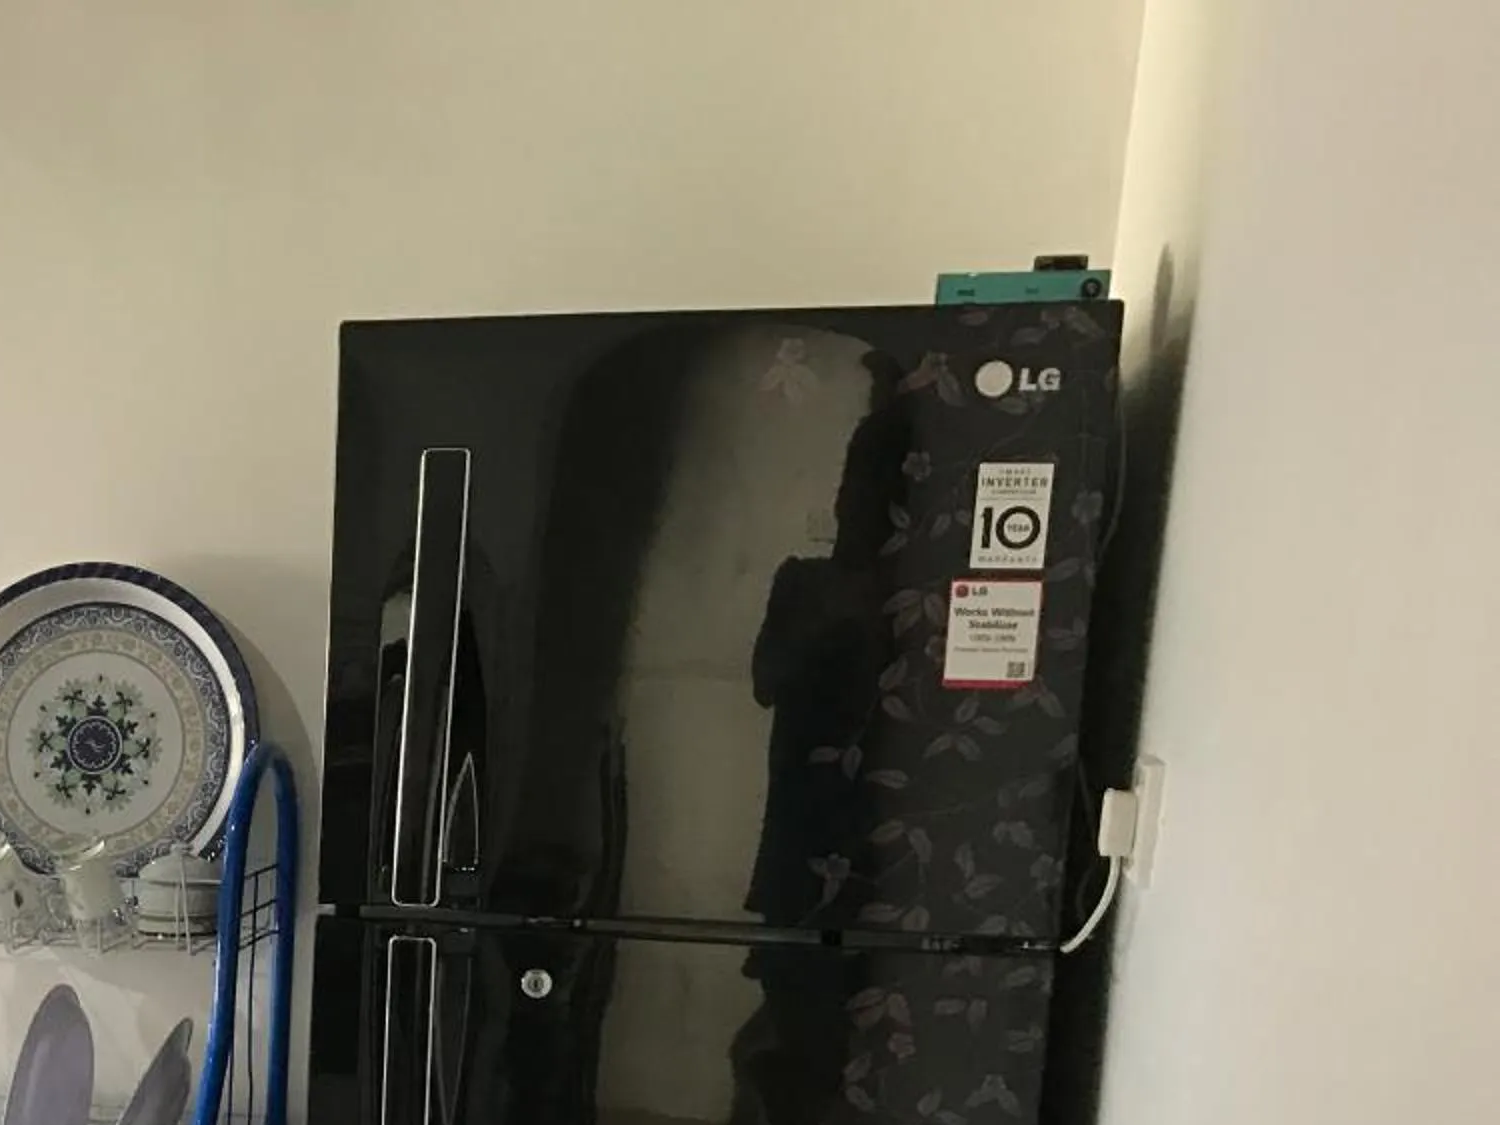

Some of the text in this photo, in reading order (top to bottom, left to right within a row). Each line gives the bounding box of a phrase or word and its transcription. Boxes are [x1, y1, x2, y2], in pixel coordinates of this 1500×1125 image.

[1018, 367, 1061, 391] LG
[981, 476, 1049, 488] INVERTER
[981, 506, 1041, 549] 10
[972, 586, 988, 596] LG
